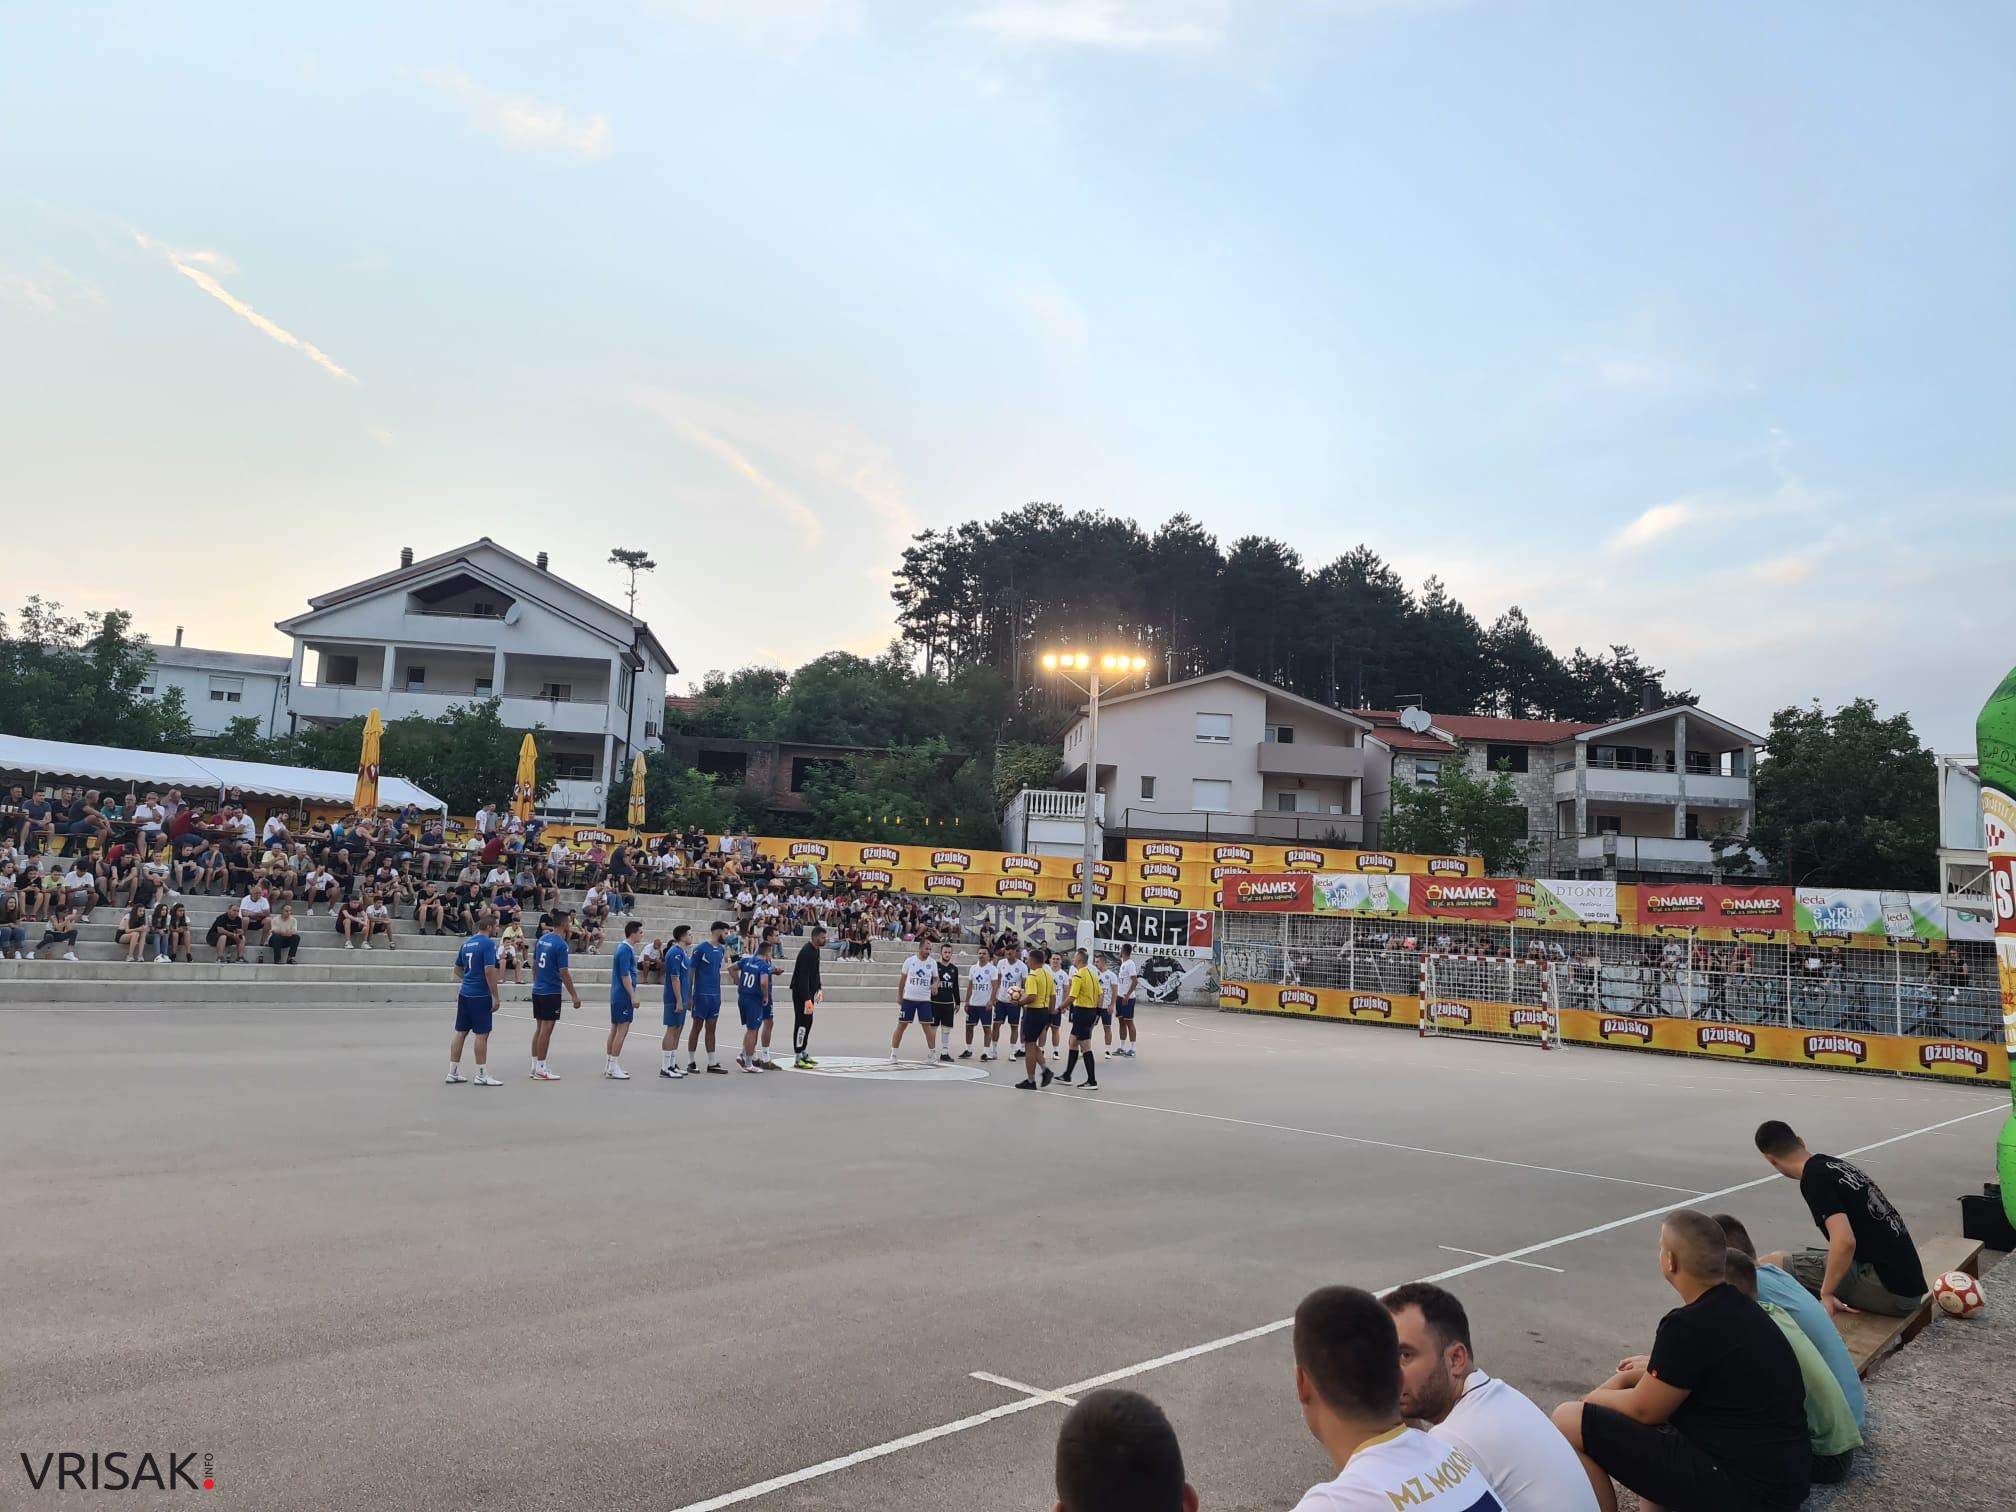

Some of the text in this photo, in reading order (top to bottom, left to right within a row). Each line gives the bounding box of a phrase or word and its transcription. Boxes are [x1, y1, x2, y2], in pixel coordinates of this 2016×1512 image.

[792, 842, 826, 856] Ožujsko
[863, 847, 897, 861] Ožujsko
[1146, 843, 1180, 857] Ožujsko
[1217, 847, 1250, 860] Ožujsko
[934, 851, 968, 866] Ožujsko
[1005, 856, 1039, 870] Ožujsko
[1288, 850, 1321, 863] Ožujsko
[1359, 855, 1393, 868] Ožujsko
[1076, 862, 1110, 876] Osko
[1144, 863, 1178, 877] Ožujsko
[1431, 859, 1465, 872] Ožujsko
[927, 874, 962, 888] Ožujsko
[1000, 878, 1033, 892] Ožujsko
[1251, 881, 1297, 894] NAMEX
[1145, 886, 1178, 900] Ožujsko
[1443, 886, 1496, 899] NAMEX
[1515, 882, 1535, 895] jsko
[1556, 886, 1614, 898] DIONIZ
[1660, 896, 1703, 906] NAMEX
[1735, 899, 1780, 909] NAMEX
[1800, 894, 1825, 905] leda
[1813, 906, 1865, 919] S VRHA
[1887, 912, 1909, 922] leda
[1095, 910, 1208, 946] PARTS
[1103, 942, 1196, 957] TEHČKI PREGLED
[465, 952, 473, 968] 7
[538, 952, 546, 968] 5
[743, 972, 755, 988] 10
[1220, 984, 1246, 999] žujsko
[1281, 988, 1315, 1005] Ožujsko
[1353, 996, 1389, 1012] Ožujsko
[1604, 1017, 1649, 1036] Ožujsko
[1702, 1027, 1751, 1046] Ožujsko
[1809, 1036, 1862, 1056] Ožujsko
[1925, 1044, 1984, 1065] Ožujsko
[1384, 1476, 1434, 1511] MZ
